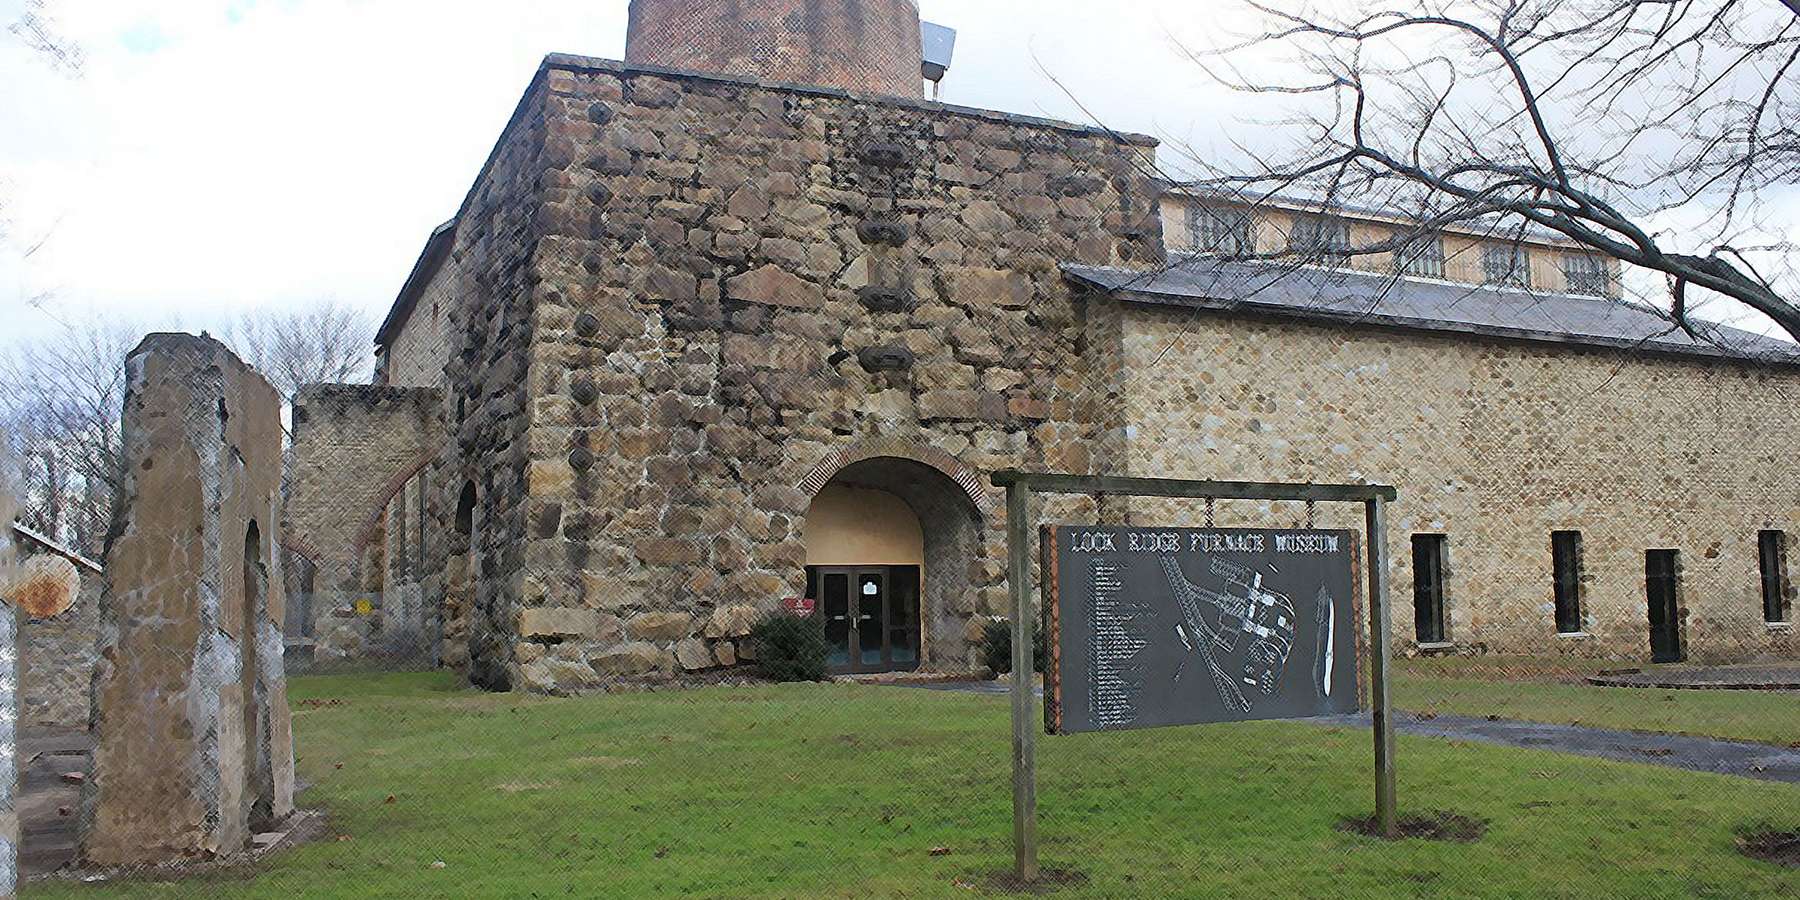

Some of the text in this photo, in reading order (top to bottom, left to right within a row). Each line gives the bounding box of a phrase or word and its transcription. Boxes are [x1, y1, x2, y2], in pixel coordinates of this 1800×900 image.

[1128, 532, 1180, 552] RIDGE
[1189, 533, 1264, 552] FURNACE
[1274, 534, 1340, 552] MUSEUM
